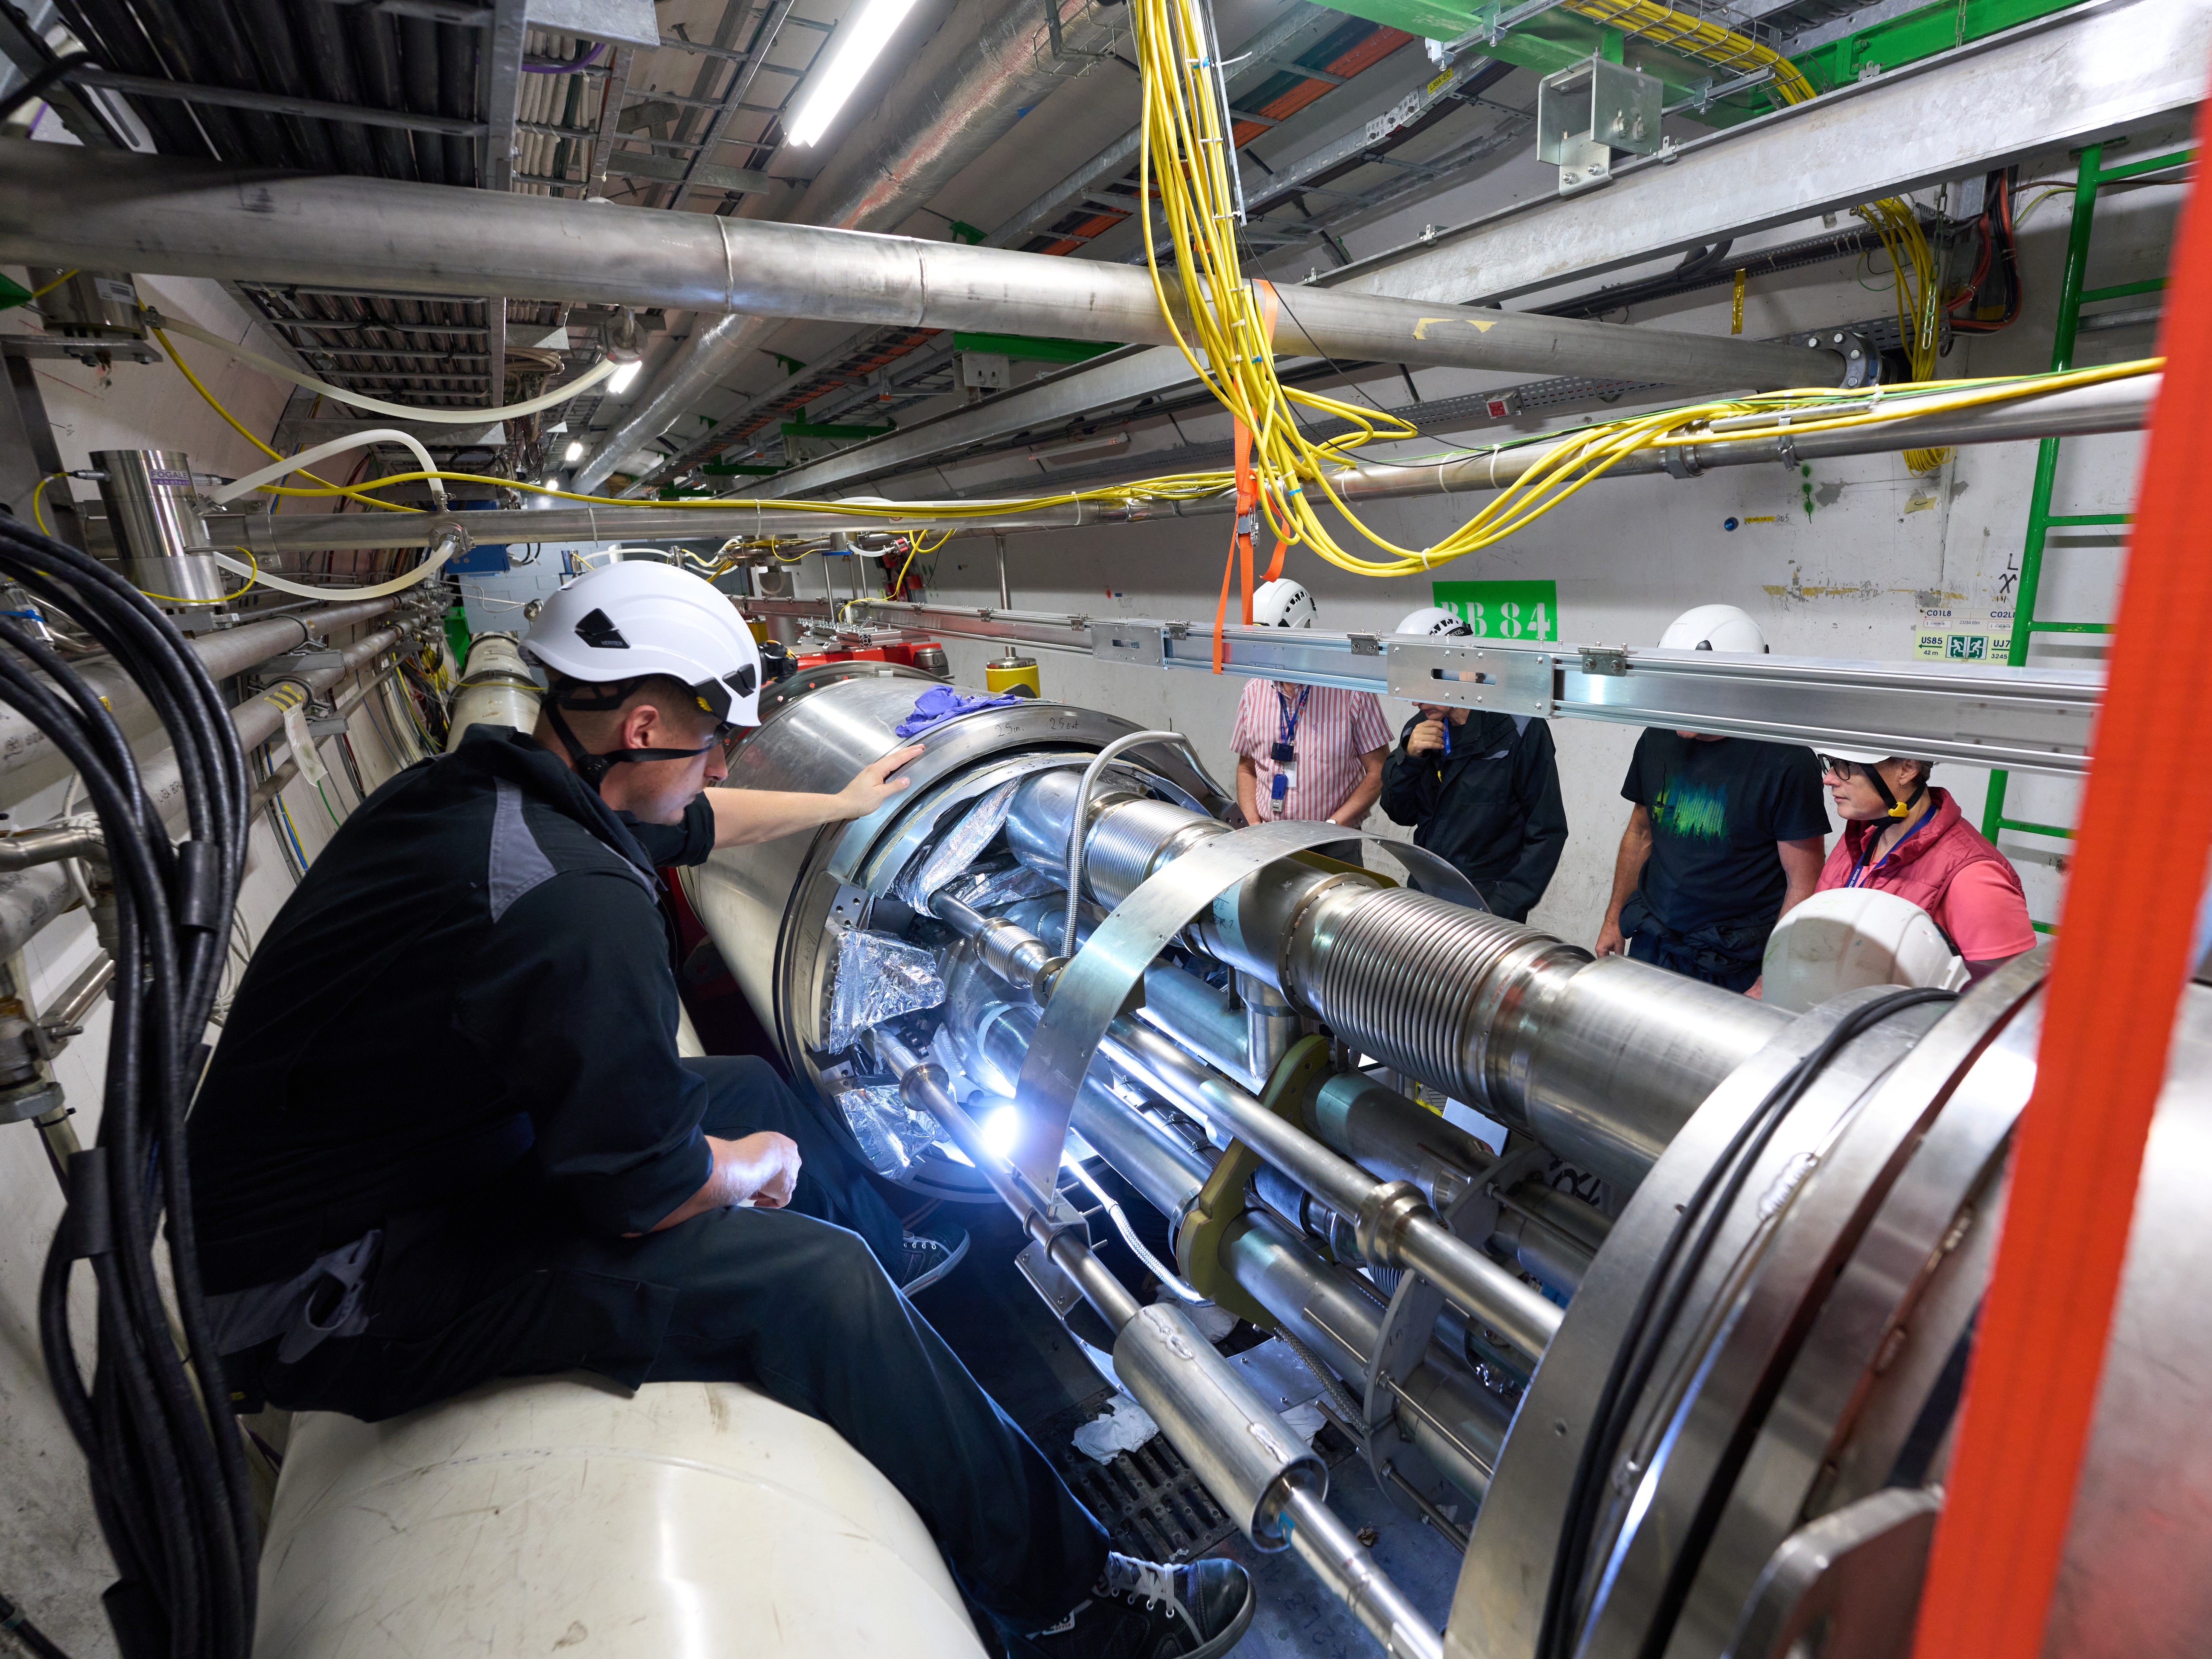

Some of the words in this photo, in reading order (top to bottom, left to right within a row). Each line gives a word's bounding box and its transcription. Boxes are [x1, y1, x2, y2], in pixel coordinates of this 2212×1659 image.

[1430, 71, 1450, 91] L38A-EC
[2007, 553, 2018, 570] L
[1500, 602, 1550, 639] 84
[1852, 868, 1860, 881] SERVICE
